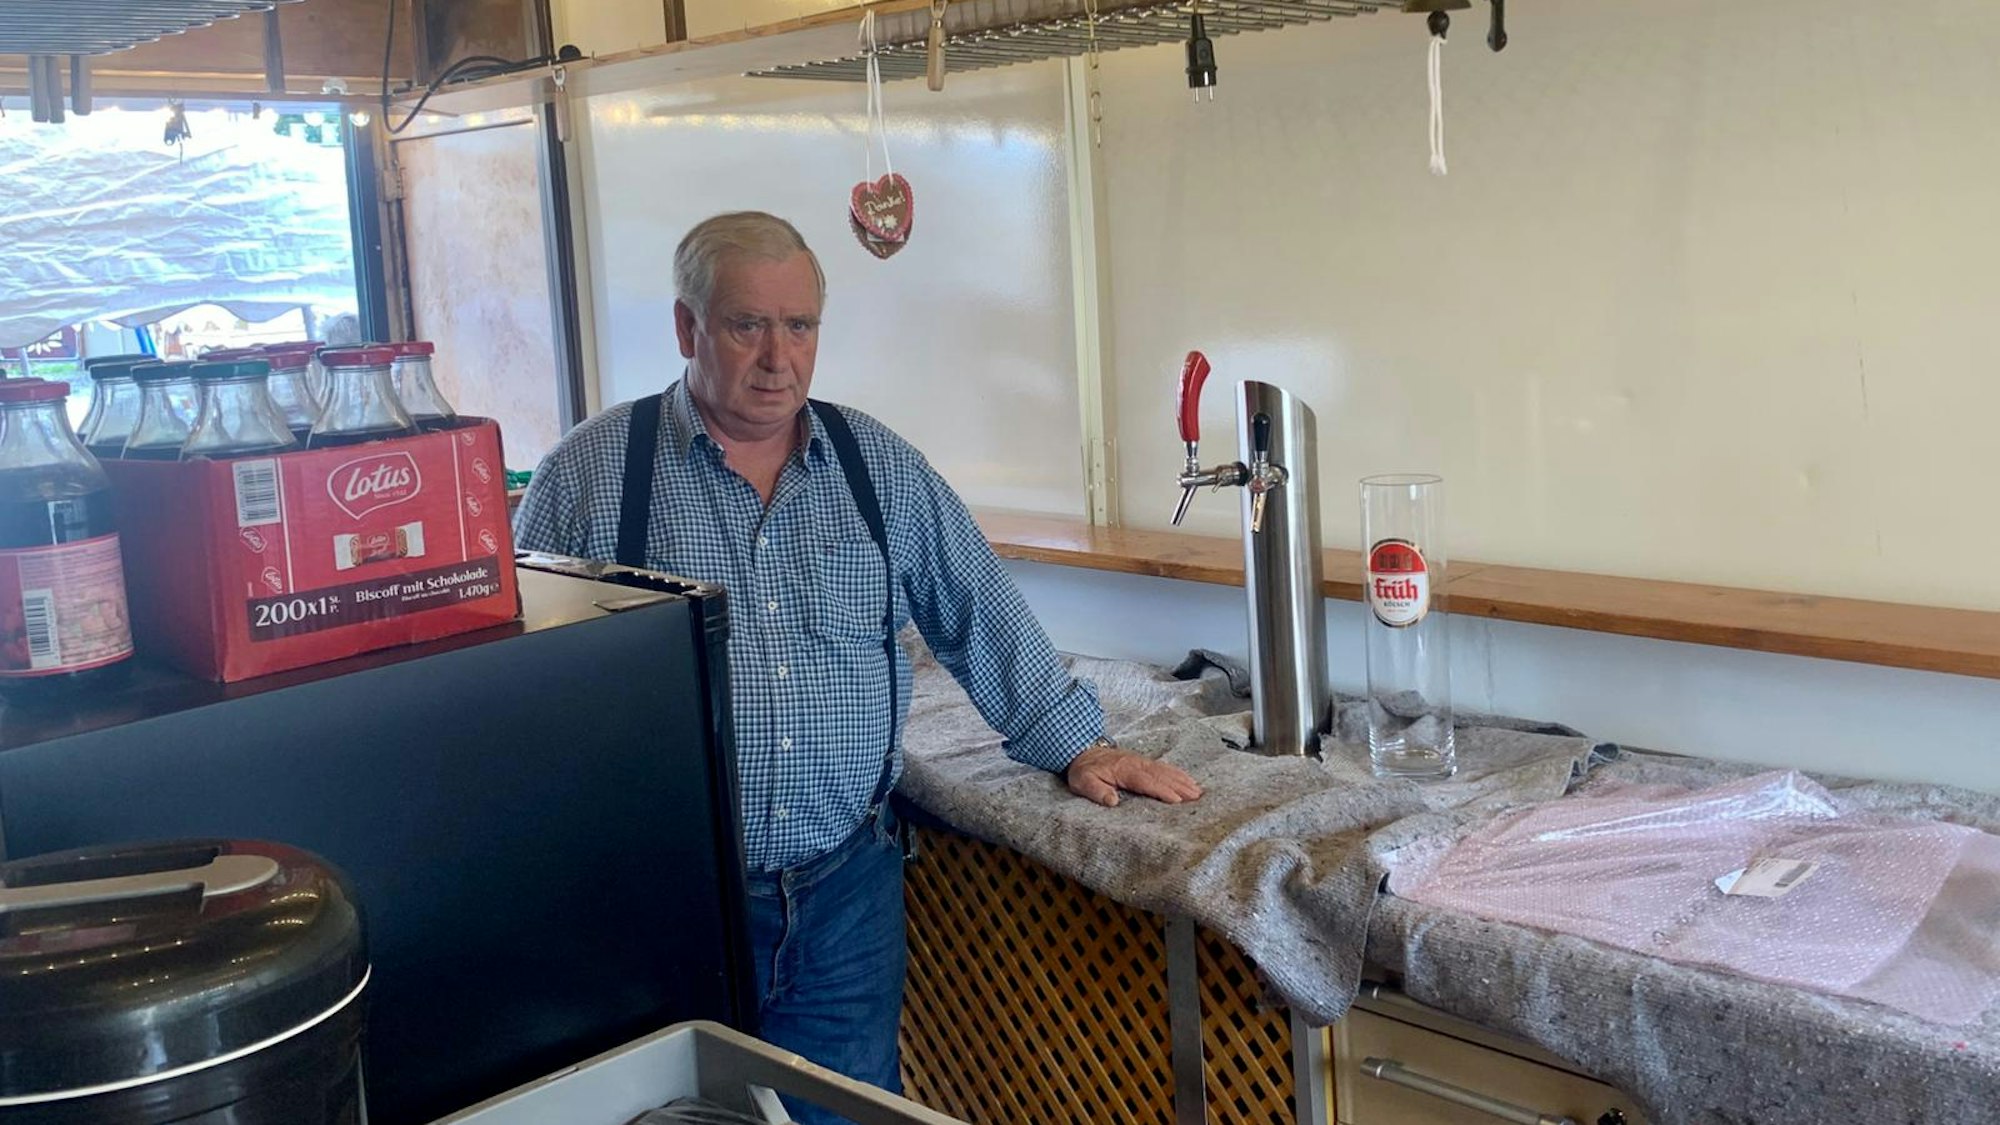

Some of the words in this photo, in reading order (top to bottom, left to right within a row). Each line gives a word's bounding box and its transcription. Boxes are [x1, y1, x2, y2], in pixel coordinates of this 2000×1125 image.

[864, 190, 906, 215] Danke!
[344, 463, 411, 502] Lotus
[355, 583, 401, 603] Biscoff
[403, 580, 424, 595] mit
[427, 567, 489, 589] Schokolade
[1373, 577, 1419, 601] früh
[255, 597, 327, 627] 200x1
